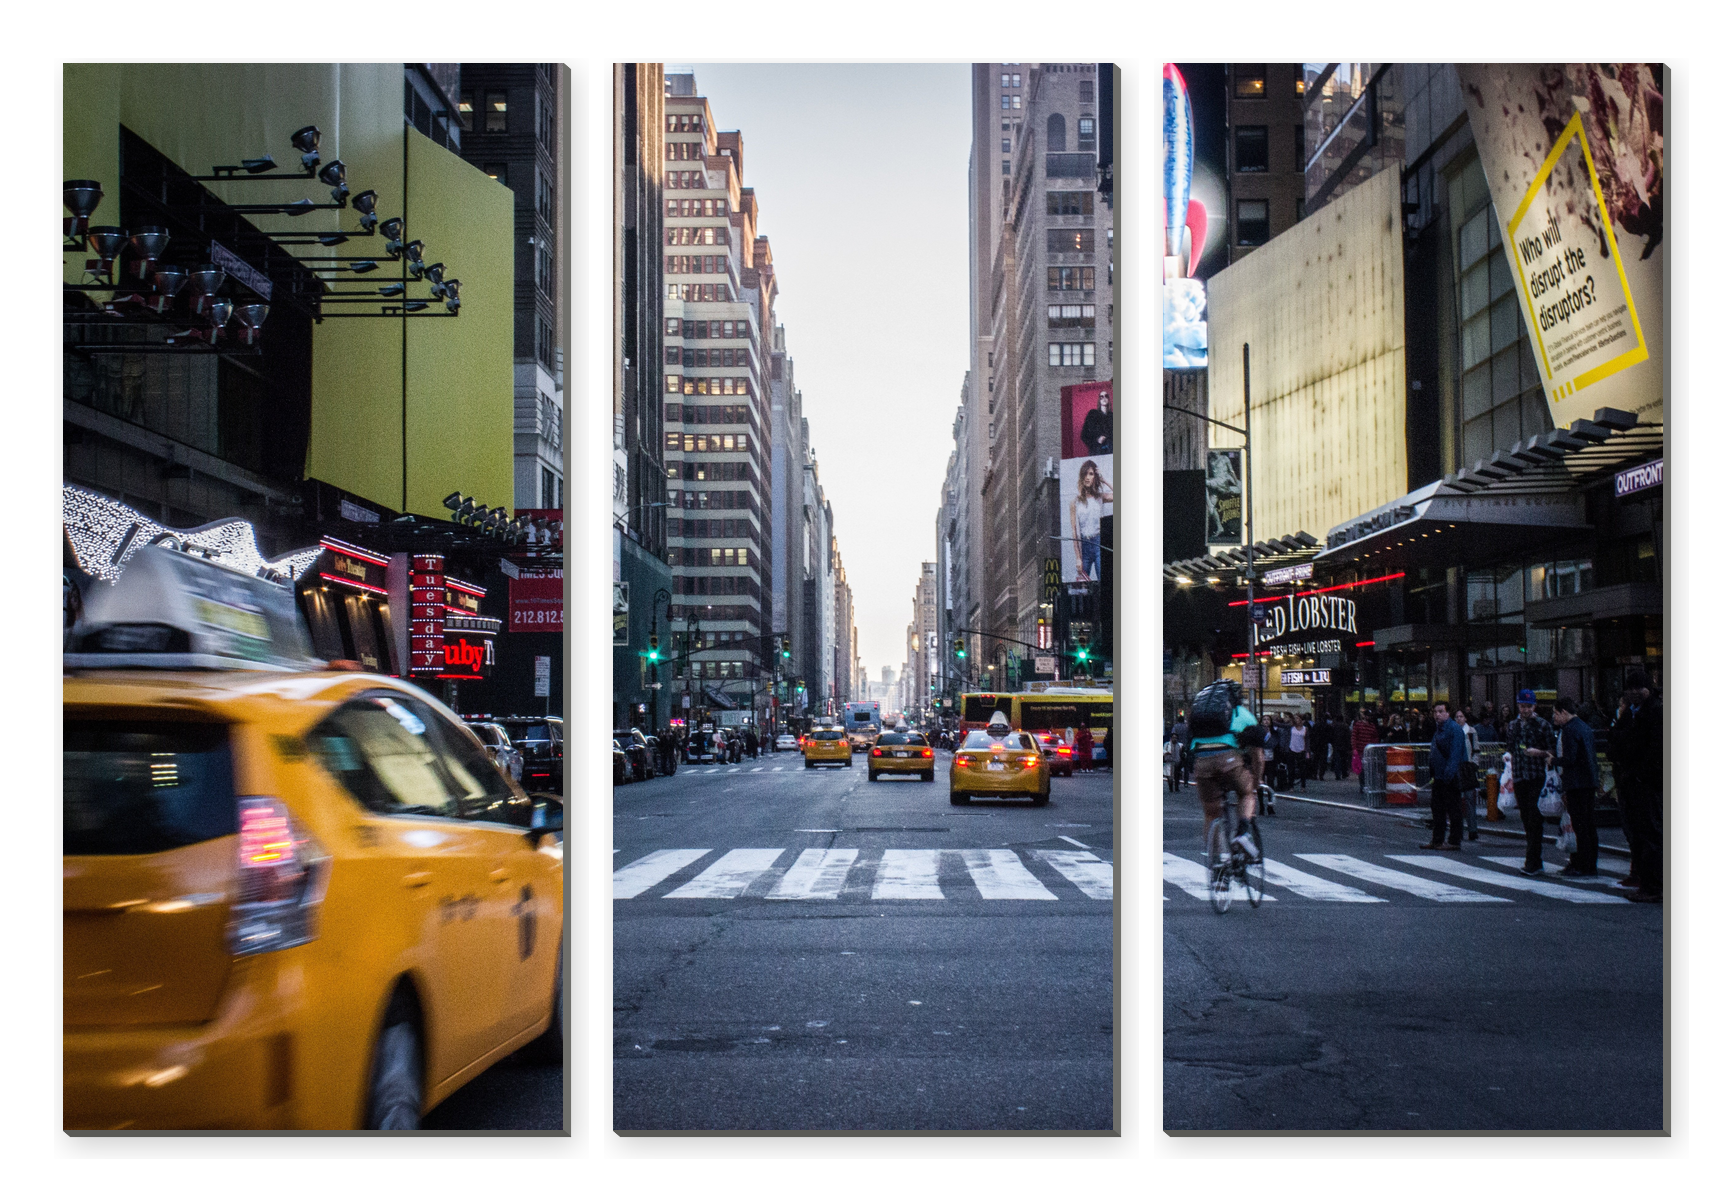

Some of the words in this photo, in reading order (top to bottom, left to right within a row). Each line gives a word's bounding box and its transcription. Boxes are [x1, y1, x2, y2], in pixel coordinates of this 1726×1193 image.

[1519, 236, 1543, 266] Who
[1541, 207, 1562, 249] will
[1530, 256, 1566, 299] disrupt
[1564, 247, 1586, 275] the
[1540, 275, 1597, 332] disruptors?
[1617, 463, 1663, 494] OUTFRONT
[424, 559, 438, 665] Tuesday
[1289, 594, 1358, 635] LOBSTER
[442, 638, 484, 672] uby
[1317, 639, 1342, 654] LOBSTER
[1287, 672, 1304, 683] FISH
